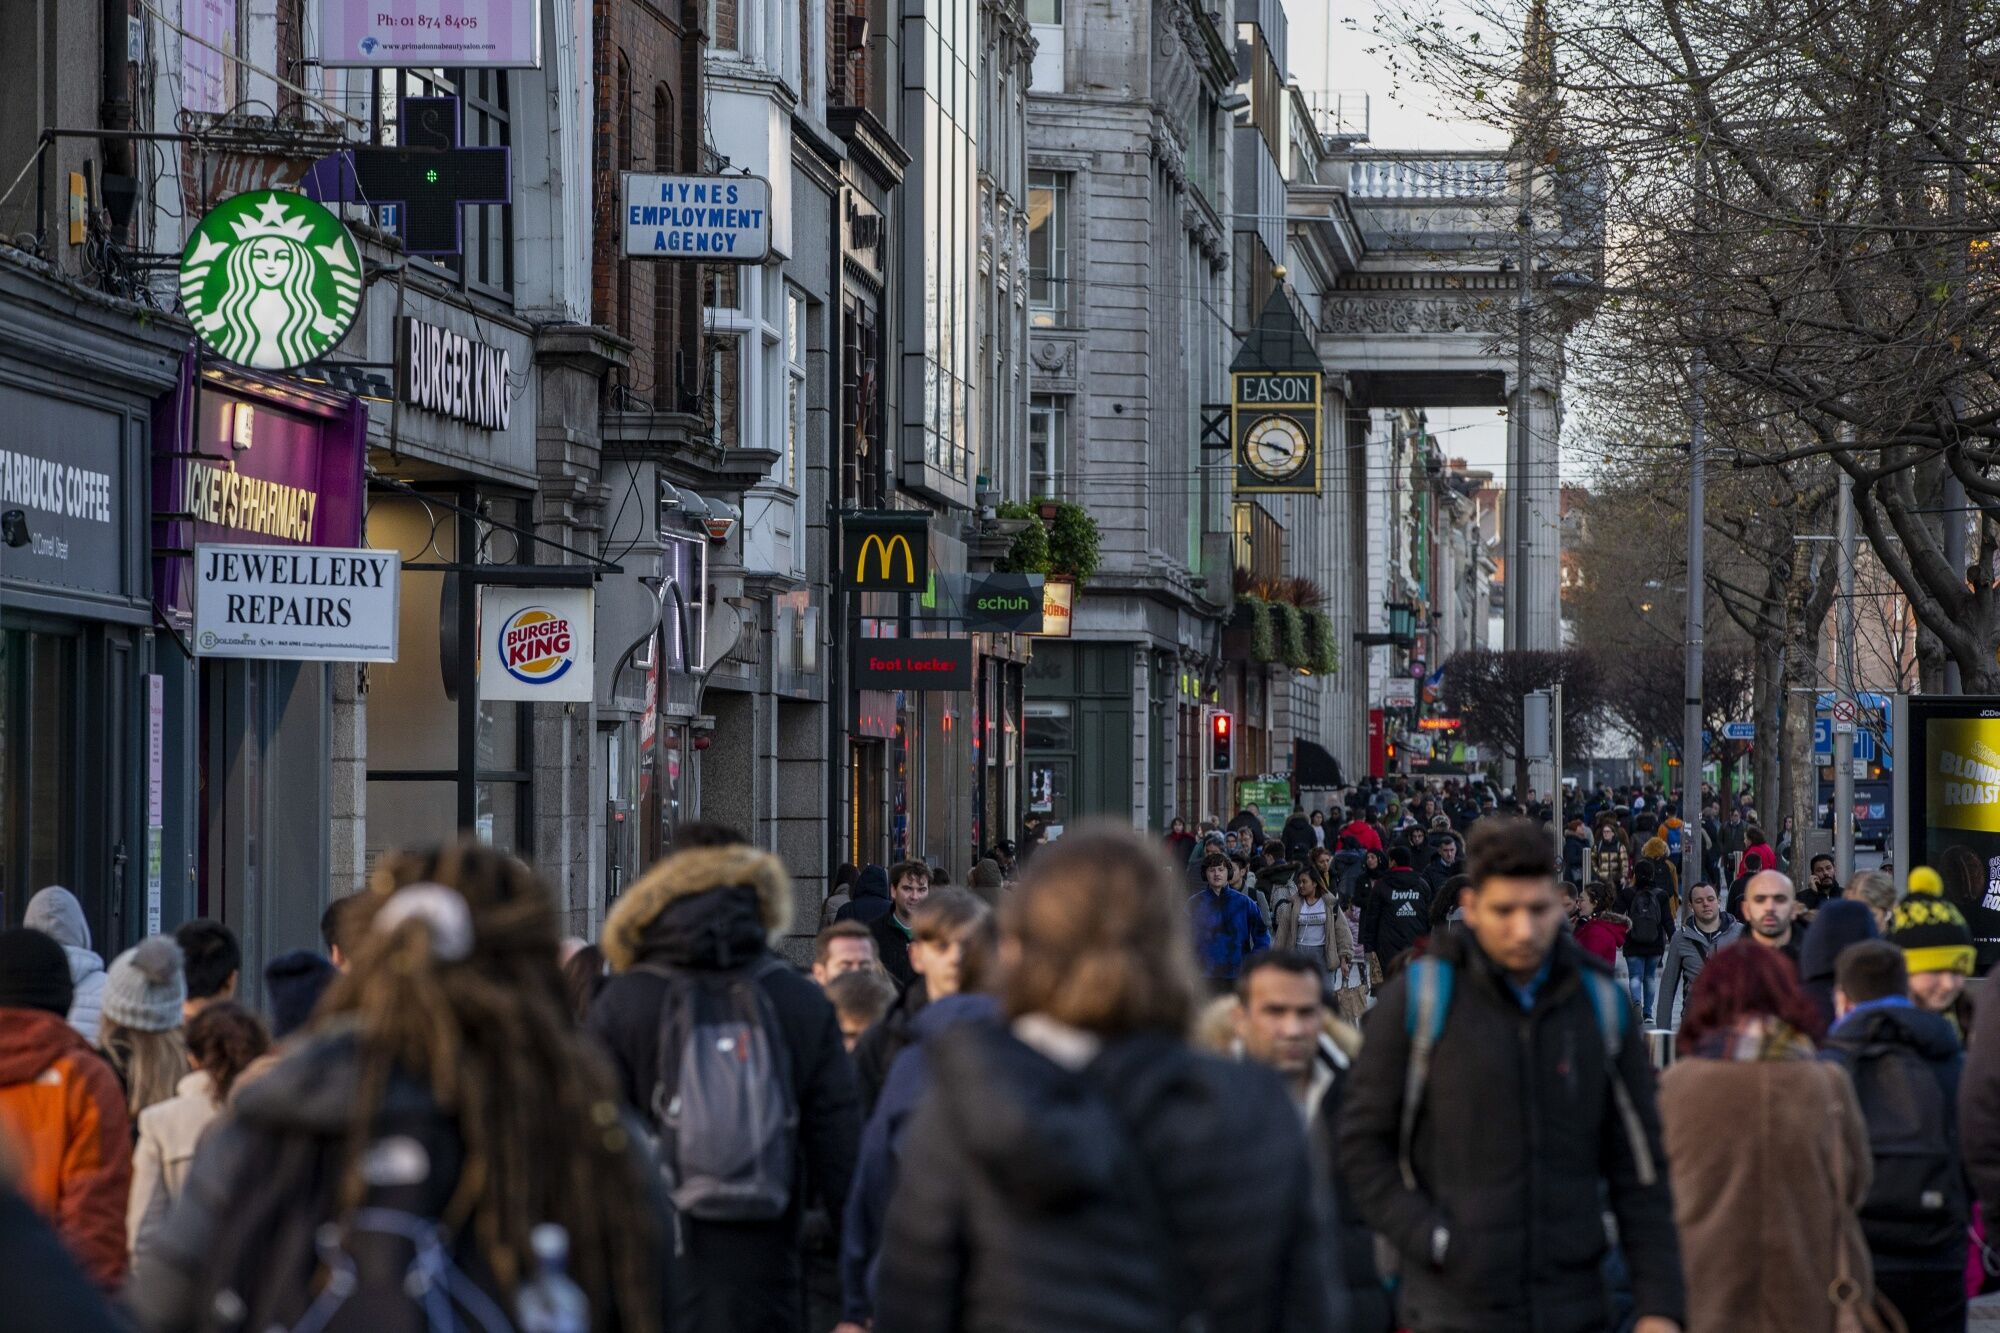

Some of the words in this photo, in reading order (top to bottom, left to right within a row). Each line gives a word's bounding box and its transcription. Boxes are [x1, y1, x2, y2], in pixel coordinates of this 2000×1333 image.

[377, 13, 398, 26] Ph:
[400, 15, 414, 26] 01
[418, 14, 441, 29] 874
[445, 14, 478, 29] 8405
[661, 183, 738, 204] HYNES
[630, 205, 763, 229] EMPLOYMENT
[654, 231, 737, 252] AGENCY
[410, 318, 472, 422] BURGER
[475, 341, 511, 431] KING
[1243, 378, 1310, 401] EASON
[66, 465, 110, 523] COFFEE
[185, 459, 240, 528] ICKEY'S
[239, 475, 316, 542] PHARMACY
[206, 552, 389, 588] JEWELLERY
[226, 594, 352, 628] REPAIRS
[977, 596, 1029, 610] schuh
[507, 620, 568, 646] BURGER
[509, 633, 571, 667] KING
[869, 656, 902, 671] Foot
[906, 656, 957, 672] Locker
[1943, 782, 2000, 806] ROAST
[1391, 888, 1420, 900] bwin
